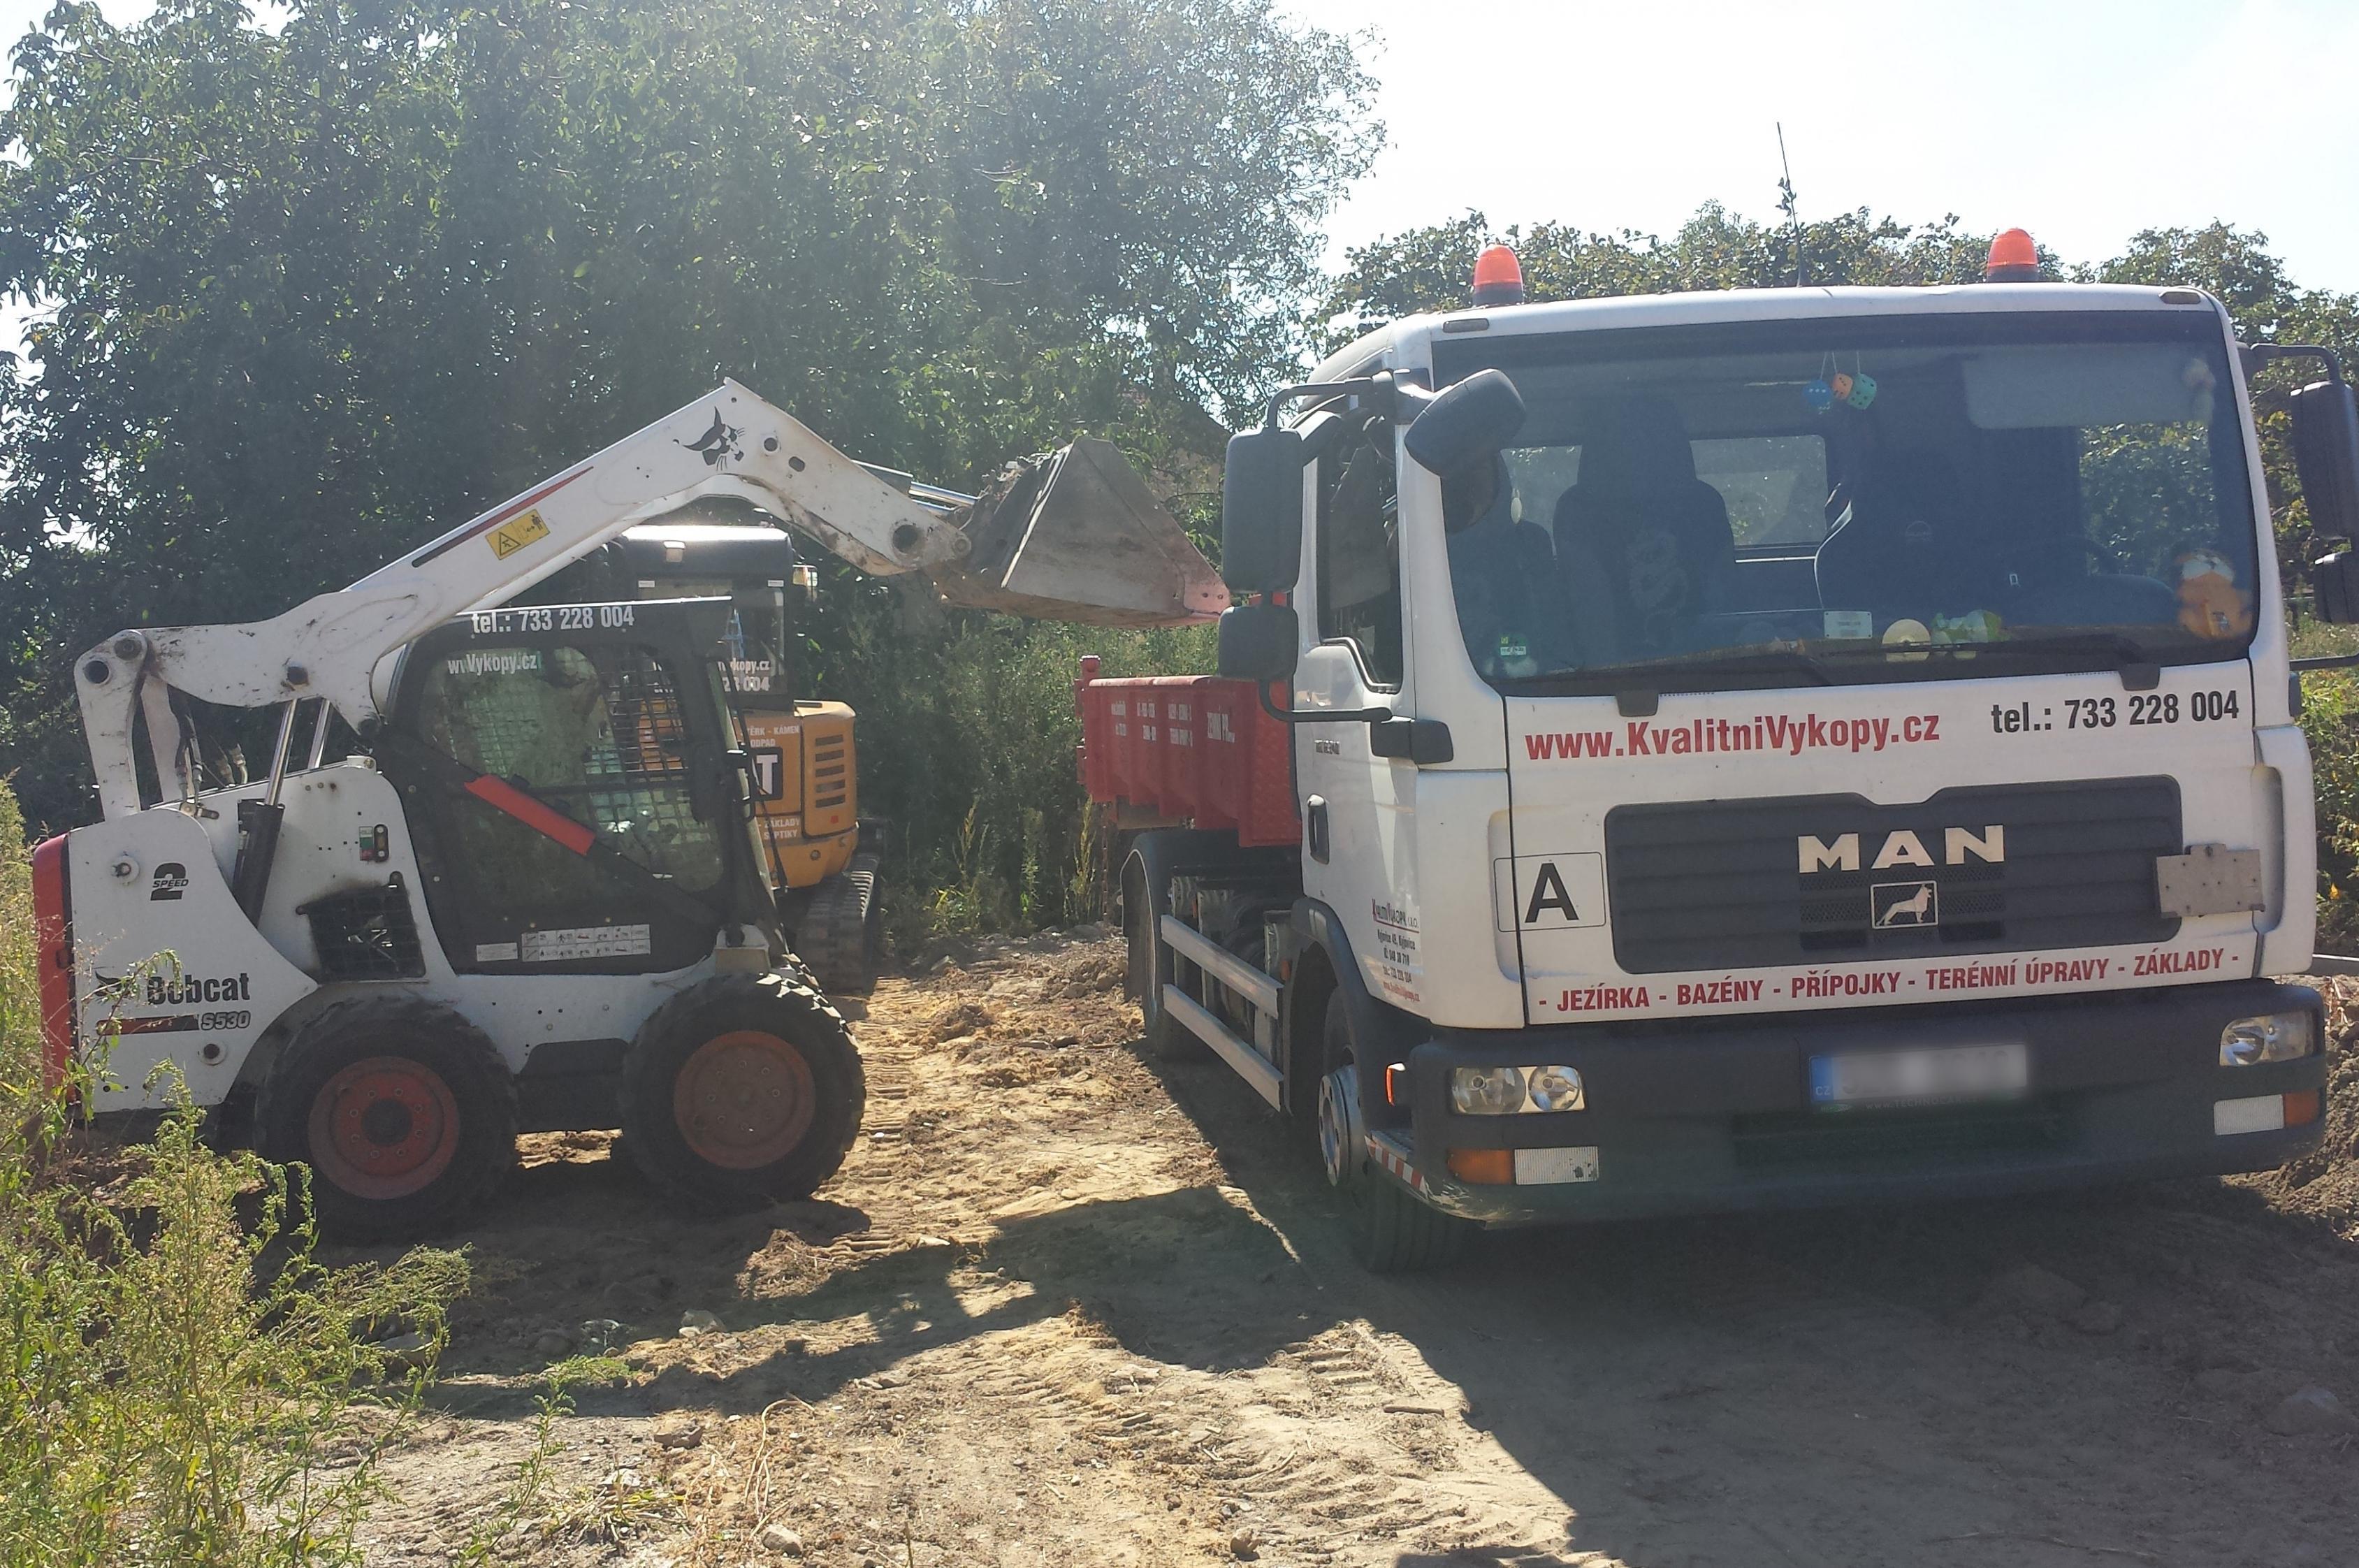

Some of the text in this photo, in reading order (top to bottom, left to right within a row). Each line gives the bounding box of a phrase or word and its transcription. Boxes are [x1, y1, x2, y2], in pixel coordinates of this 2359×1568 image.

[471, 604, 634, 634] tel.: 733 228 004
[1991, 690, 2240, 734] tel.: 733 228 004
[1525, 713, 1940, 760] www.KvalitniVykopy.cz
[764, 829, 798, 840] SPTIKY
[1797, 824, 2005, 873] MAN
[150, 862, 187, 901] 2
[152, 878, 189, 888] SPEED
[1524, 862, 1579, 924] A
[147, 972, 250, 1006] Bobcat
[1677, 975, 1763, 1005] BAZÉNY
[1791, 971, 1901, 998] PŘÍPOJKY
[1926, 959, 2017, 990] TERÉNNÍ
[2025, 957, 2110, 985] ÚPRAVY
[2133, 948, 2225, 976] ZÁKLADY
[201, 1010, 252, 1031] S530
[1815, 1085, 1831, 1096] CZ
